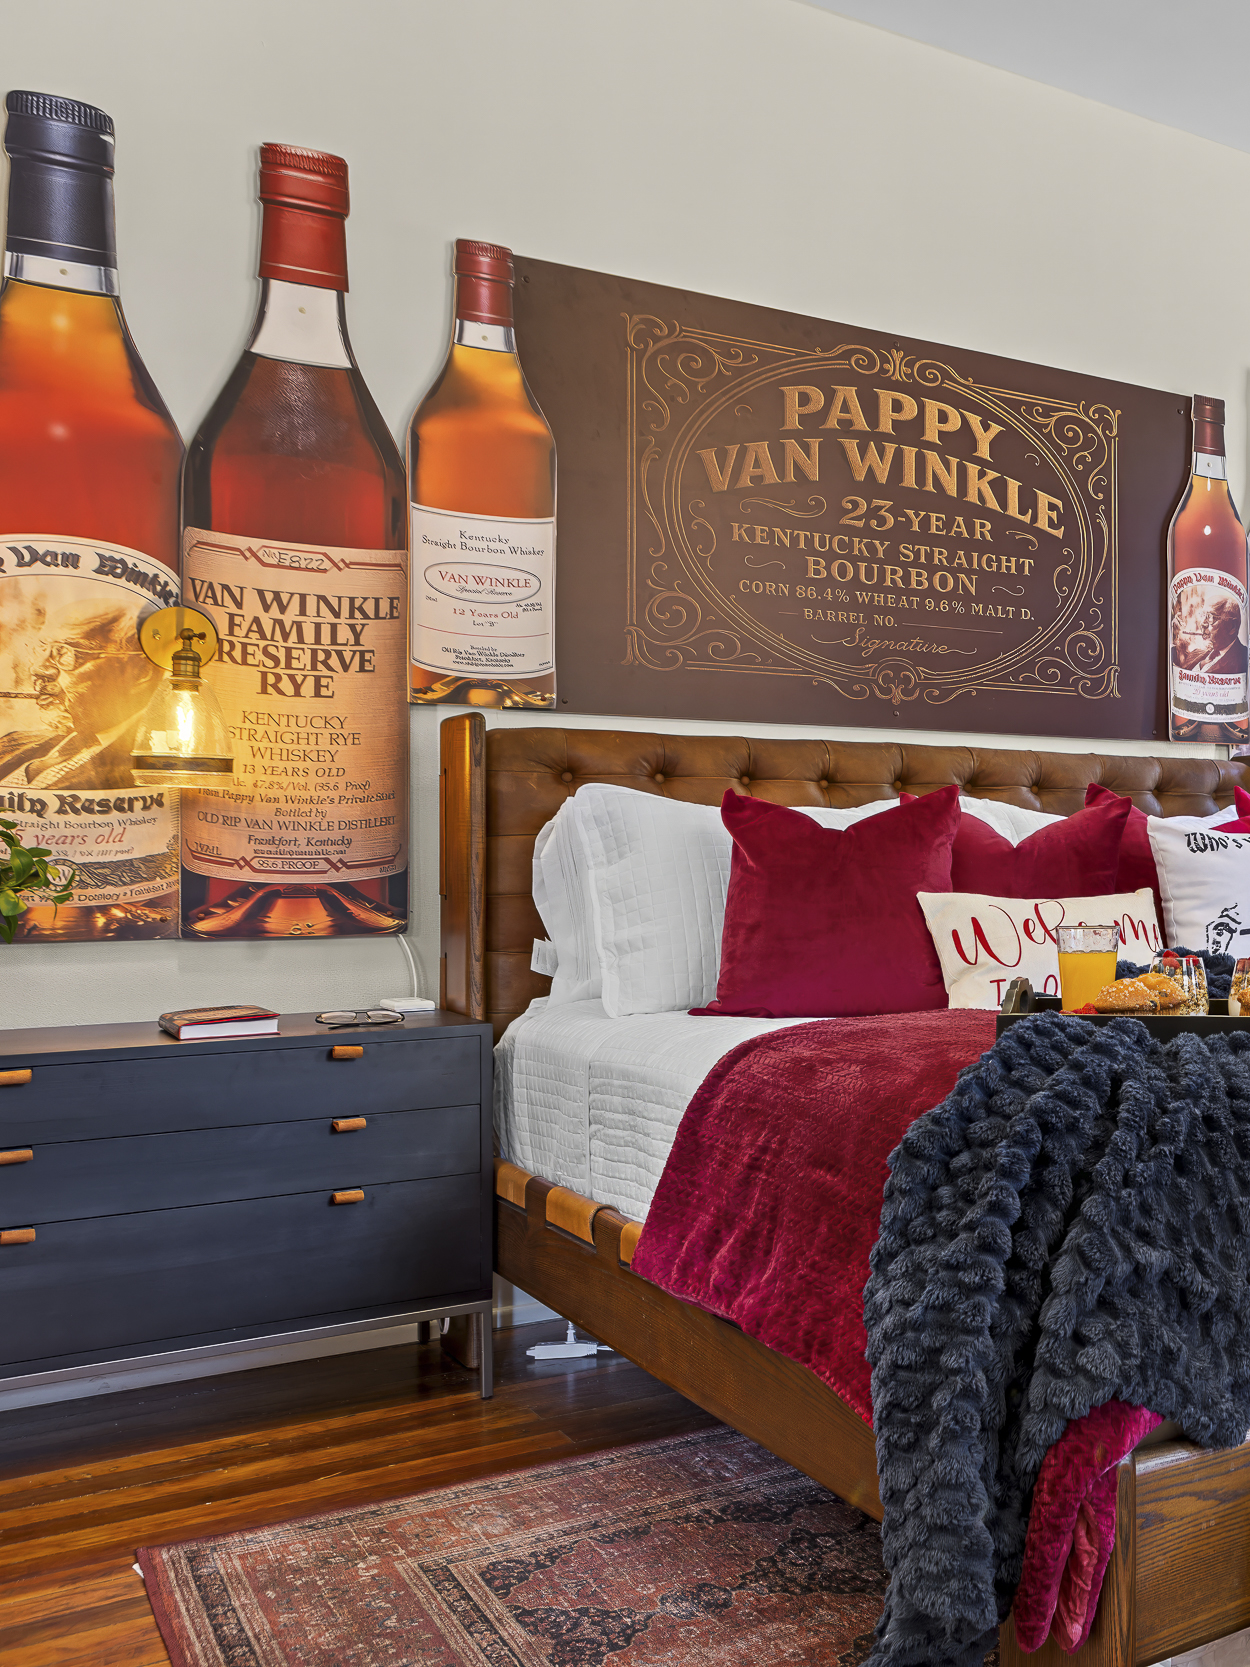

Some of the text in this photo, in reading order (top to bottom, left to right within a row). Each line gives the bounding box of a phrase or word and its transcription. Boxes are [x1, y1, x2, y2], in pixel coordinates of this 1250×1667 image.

[778, 384, 1006, 462] PAPPY
[695, 438, 1065, 540] VAN WINKLE
[838, 495, 994, 542] 23-YEAR
[422, 534, 545, 557] Straight Bourbon Whiskey
[459, 530, 510, 545] Kentucky
[6, 545, 82, 570] Van
[730, 522, 1035, 577] KENTUCKY STRAIGHT
[438, 569, 532, 588] VAN WINKLE
[804, 556, 979, 596] BOURBON
[1193, 572, 1214, 583] Van
[188, 576, 400, 620] VAN WINKLE
[738, 579, 1035, 621] CORN 86.4% WHEAT 9.6% MALT D.
[453, 607, 519, 619] 12 Years Old
[803, 608, 898, 627] BARREL NO.
[224, 611, 370, 646] FAMILY
[835, 627, 953, 657] Signature
[214, 638, 376, 674] RESERVE
[256, 669, 335, 698] RYE
[241, 710, 348, 730] KENTUCKY
[229, 725, 361, 746] STRAIGHT RYE
[249, 745, 339, 763] WHISKEY
[242, 764, 346, 777] 13 YEARS OLD
[222, 789, 255, 805] Pappy
[259, 793, 280, 804] Van
[284, 795, 335, 805] Winkle's
[197, 811, 219, 824] OLD
[221, 815, 242, 827] RIP
[244, 817, 273, 830] VAN
[277, 820, 335, 832] WINKLE
[274, 807, 328, 820] Bottled by
[64, 820, 114, 829] Bourbon
[33, 833, 89, 848] years
[95, 827, 127, 845] old
[1184, 831, 1243, 853] Who's
[281, 860, 320, 870] PROOF
